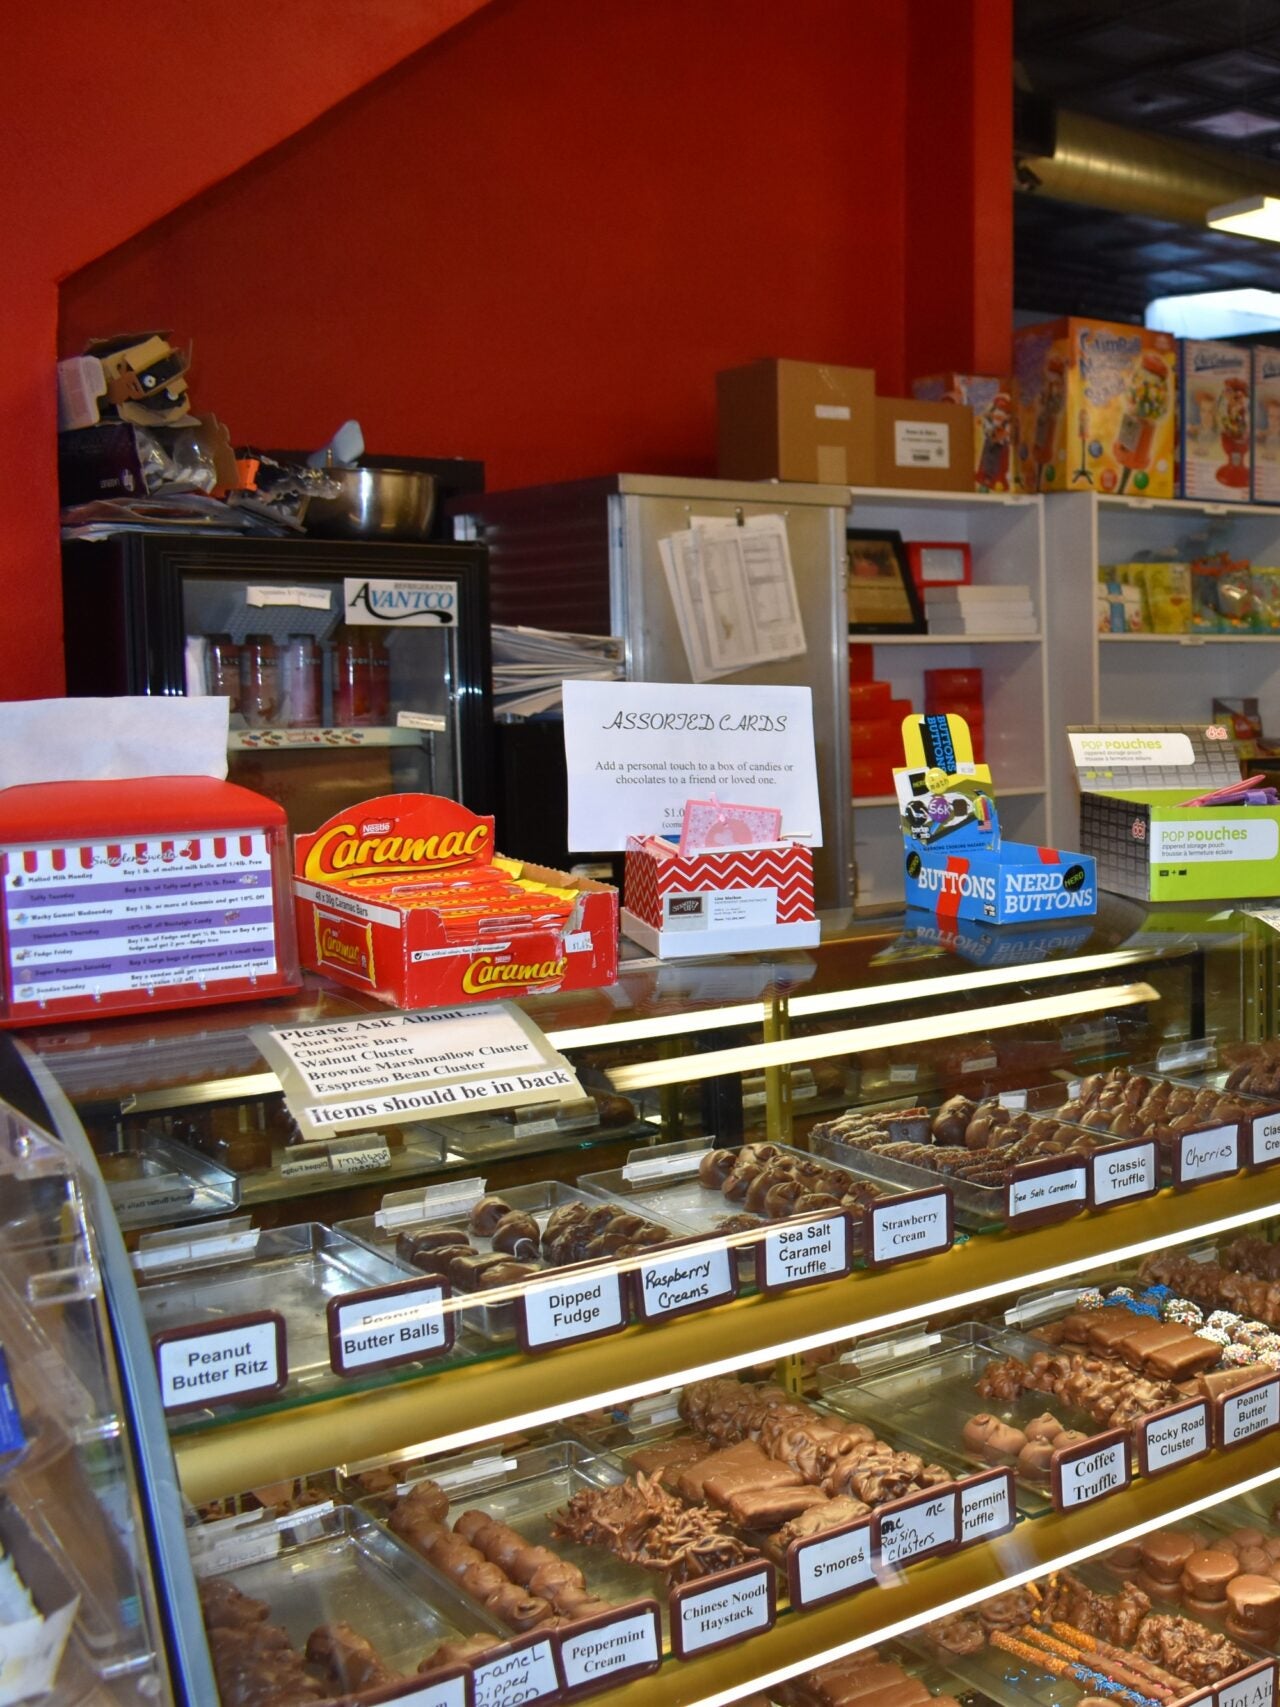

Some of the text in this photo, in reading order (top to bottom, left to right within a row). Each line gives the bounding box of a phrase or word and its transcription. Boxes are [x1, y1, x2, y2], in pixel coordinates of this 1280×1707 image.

[349, 582, 454, 623] AVANTCO
[603, 711, 787, 732] ASSORTED CARDS
[937, 716, 956, 773] BUTTONS
[1081, 741, 1102, 750] POP
[595, 761, 616, 771] Add
[627, 761, 667, 774] personal
[670, 762, 696, 771] touch
[698, 763, 707, 771] to
[718, 762, 735, 771] box
[737, 762, 747, 771] of
[749, 762, 782, 772] candies
[616, 775, 666, 785] chocolates
[668, 776, 678, 784] to
[689, 775, 717, 785] friend
[731, 775, 756, 785] loved
[664, 807, 685, 818] $1.0
[1162, 831, 1184, 842] POP
[1186, 842, 1207, 850] storage
[305, 825, 488, 881] Caramac
[918, 867, 995, 900] BUTTONS
[1006, 873, 1063, 892] NERD
[1065, 872, 1084, 888] NERD
[1005, 889, 1092, 913] BUTTONS
[280, 1021, 347, 1041] Please
[356, 1018, 394, 1032] Ask
[292, 1033, 367, 1049] Mint Bars
[294, 1035, 408, 1058] Chocolate Bars
[302, 1046, 415, 1068] Walnut Cluster
[308, 1041, 529, 1081] Brownie Marshmallow Cluster
[315, 1060, 485, 1093] Esspresso Bean Cluster
[311, 1069, 570, 1124] Items should be in back
[1109, 1158, 1146, 1175] Classic
[1185, 1144, 1232, 1167] Cherries
[1030, 1186, 1045, 1199] Salt
[1048, 1179, 1077, 1194] Caramel
[1110, 1172, 1145, 1189] Truffle
[882, 1211, 938, 1232] Strawberry
[779, 1224, 831, 1245] Sea Salt
[892, 1229, 926, 1245] Cream
[779, 1241, 831, 1262] Caramel
[645, 1260, 710, 1290] Raspberry
[785, 1259, 826, 1278] Truffle
[549, 1285, 601, 1309] Dipped
[658, 1283, 708, 1308] Creams
[553, 1305, 600, 1327] Fudge
[344, 1322, 439, 1354] Butter Balls
[188, 1344, 251, 1366] Peanut
[172, 1360, 268, 1390] Butter Ritz
[1237, 1390, 1268, 1409] Peanut
[1238, 1404, 1266, 1422] Butter
[1148, 1416, 1204, 1447] Rocky Road
[1233, 1418, 1269, 1438] Graham
[1160, 1435, 1195, 1456] Cluster
[1075, 1450, 1115, 1478] Coffee
[1073, 1473, 1118, 1501] Truffle
[962, 1491, 1006, 1516] permint
[962, 1512, 994, 1529] ruffle
[683, 1598, 729, 1622] Chinese
[700, 1605, 754, 1633] Haystack
[572, 1629, 645, 1659] Peppermint
[583, 1652, 626, 1673] Cream
